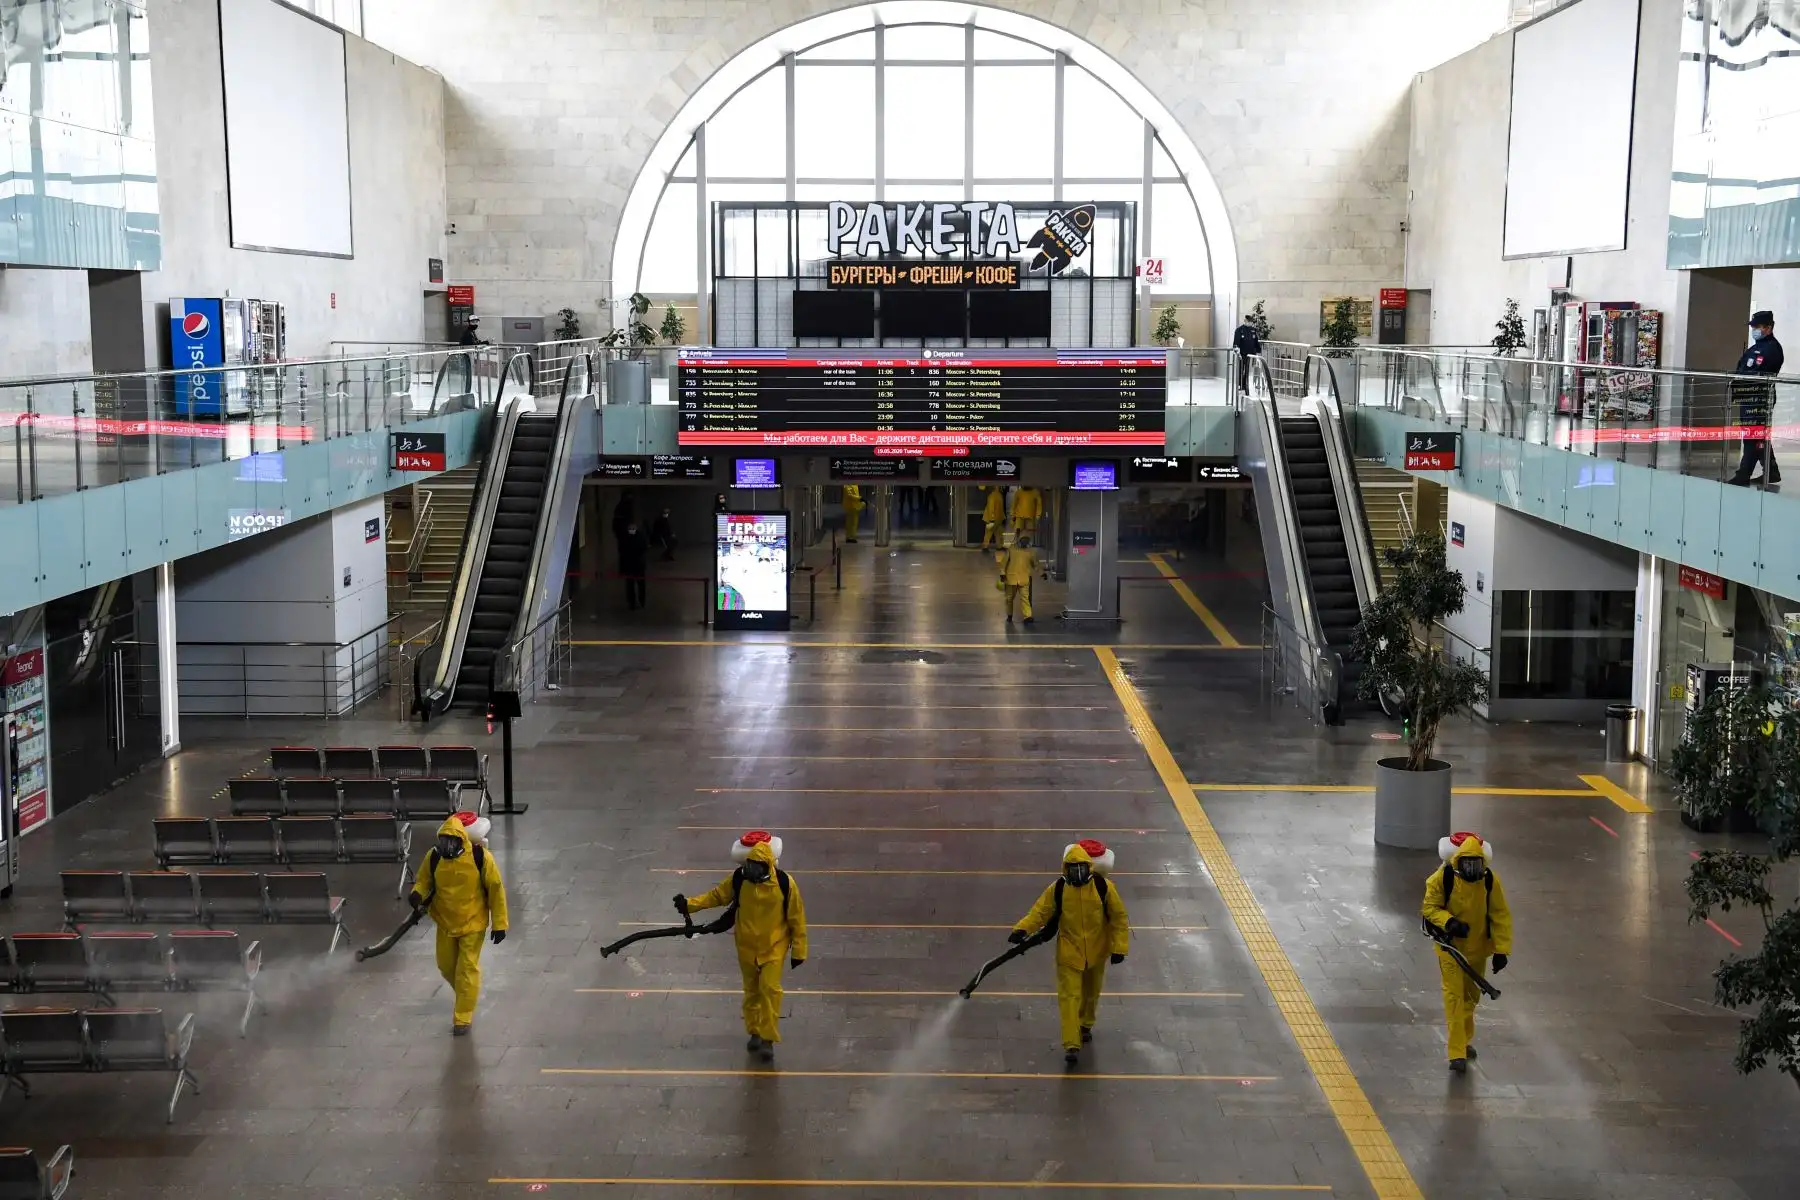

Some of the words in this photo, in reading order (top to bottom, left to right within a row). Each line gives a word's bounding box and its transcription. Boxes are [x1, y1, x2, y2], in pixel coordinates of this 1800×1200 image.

[827, 202, 1020, 257] РАКЕТА
[1047, 214, 1086, 255] РАКЕТА
[1145, 259, 1163, 276] 24
[831, 266, 896, 286] БУРГЕРЫ
[909, 265, 964, 284] ФРЕШИ
[975, 266, 1017, 285] КОФЕ
[932, 351, 964, 359] Departure
[187, 343, 211, 400] pepsi
[763, 434, 781, 442] Мы
[784, 433, 828, 445] работаем
[830, 435, 847, 444] для
[850, 433, 867, 443] Вас
[875, 435, 916, 445] держите
[918, 435, 975, 444] дистанцию,
[977, 432, 1020, 445] берегите
[1022, 433, 1043, 443] себя
[1045, 435, 1052, 443] и
[943, 460, 950, 468] К
[952, 461, 993, 470] поездам
[727, 522, 777, 535] ГЕРОИ
[727, 535, 757, 544] СРЕДИ
[758, 535, 777, 543] НАС
